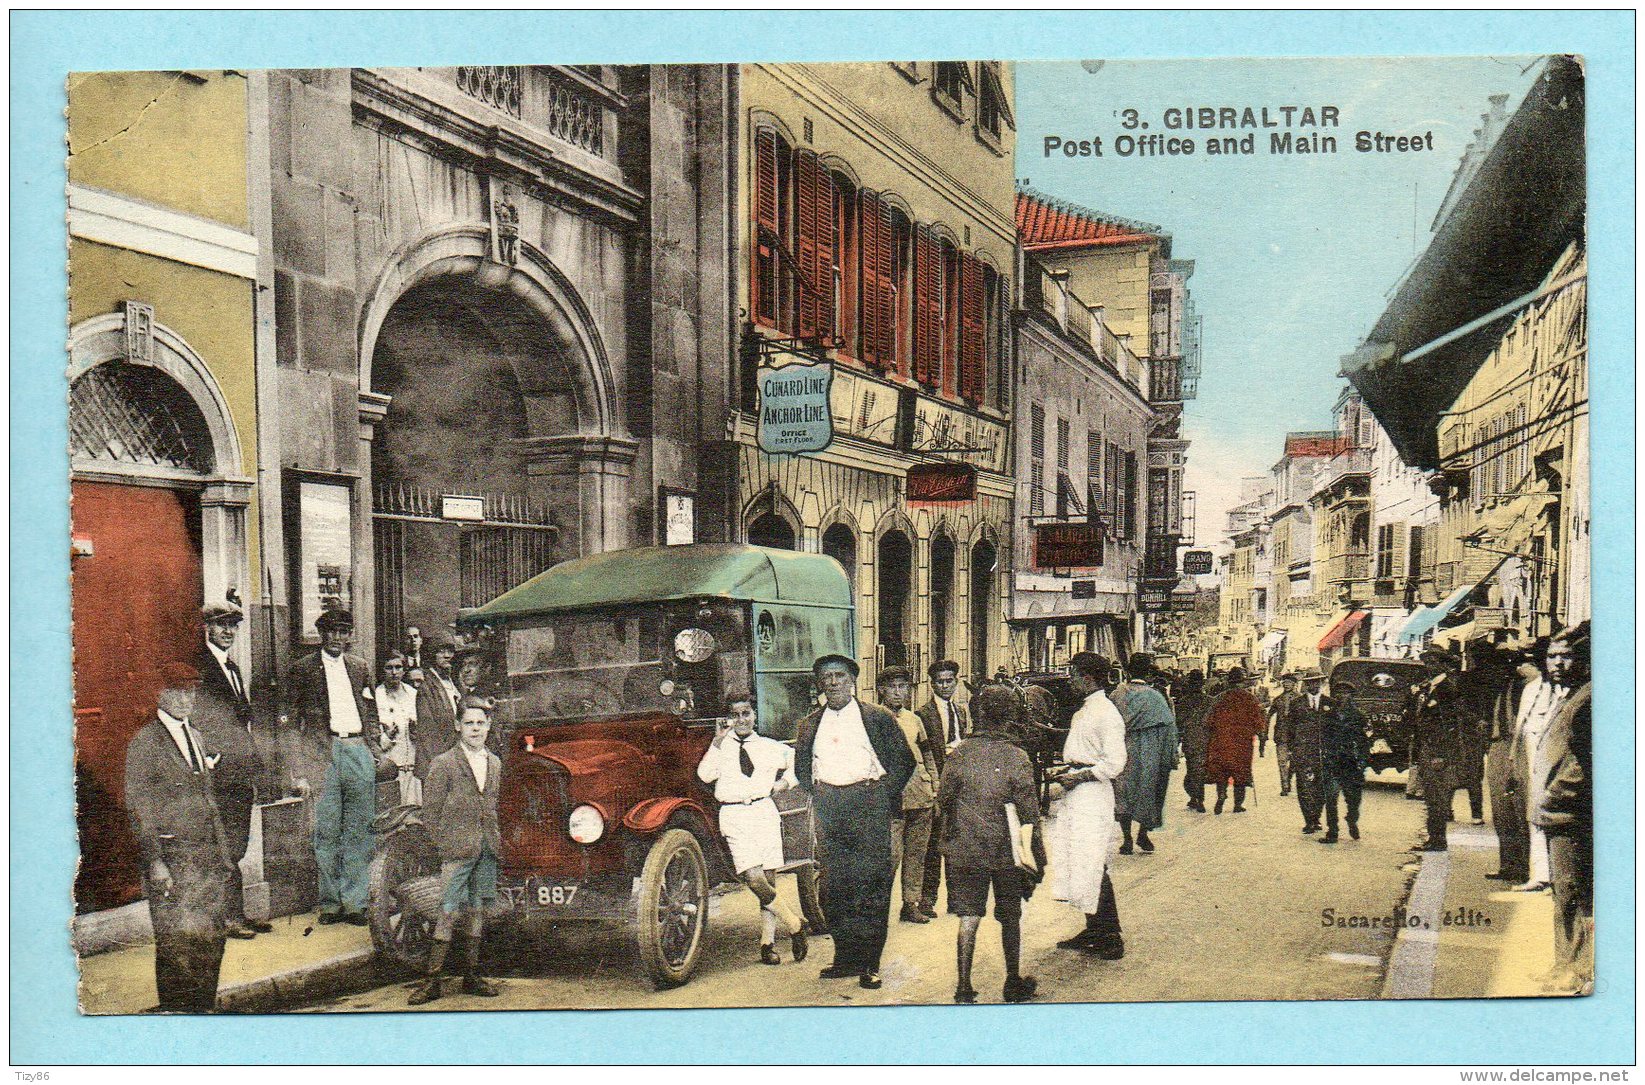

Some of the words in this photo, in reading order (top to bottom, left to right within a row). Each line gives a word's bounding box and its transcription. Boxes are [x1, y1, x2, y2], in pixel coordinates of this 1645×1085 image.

[764, 379, 803, 398] CUNARD
[804, 376, 825, 395] LINE
[763, 406, 803, 426] ANCHOR
[804, 403, 825, 423] LINE
[538, 886, 578, 905] 887
